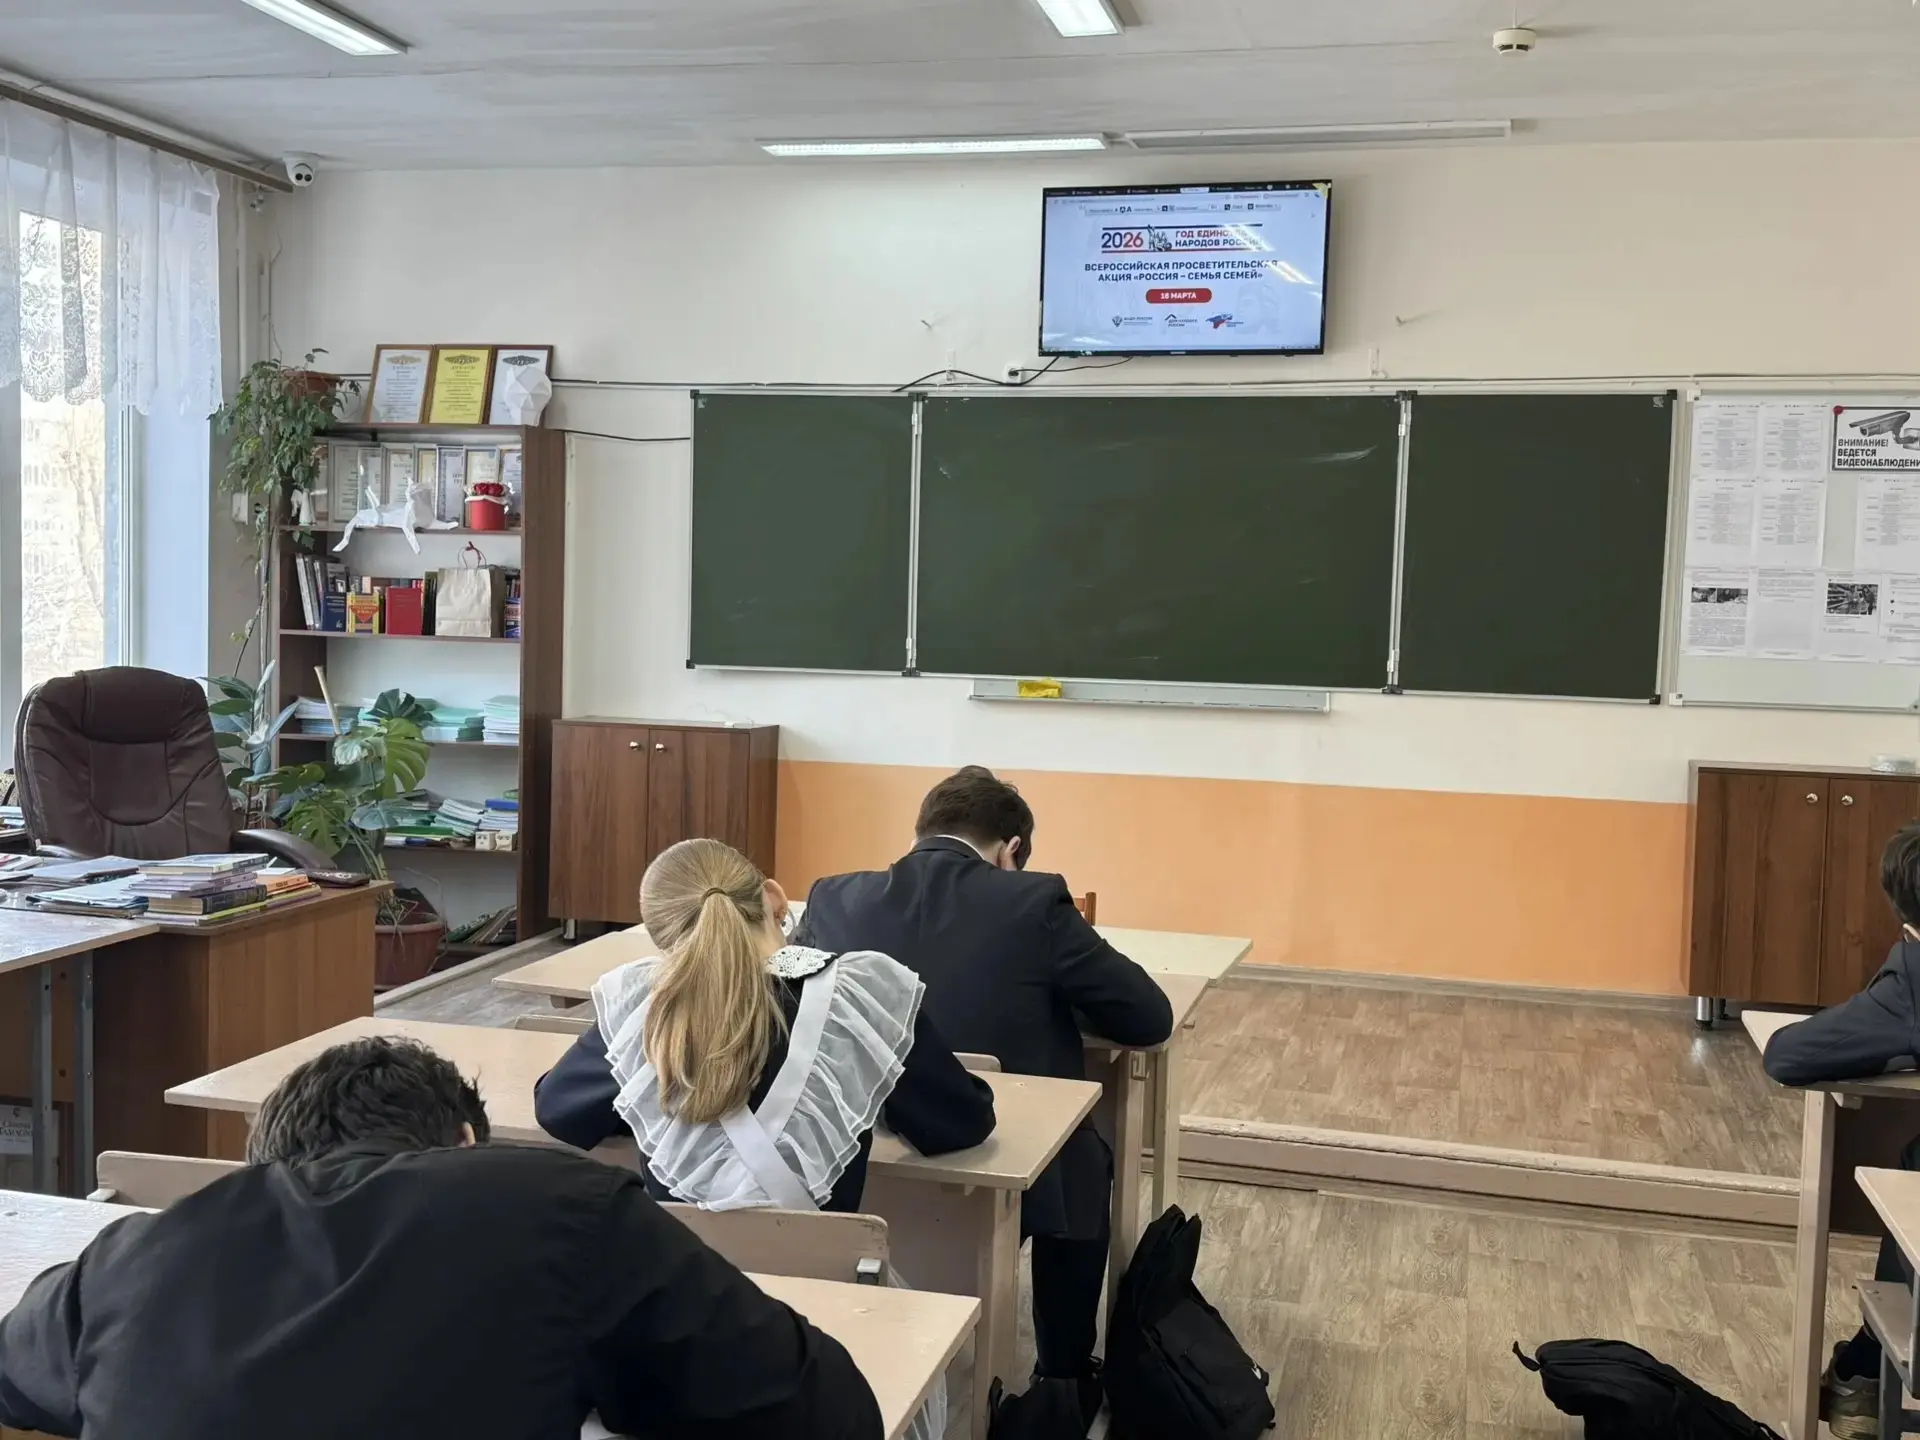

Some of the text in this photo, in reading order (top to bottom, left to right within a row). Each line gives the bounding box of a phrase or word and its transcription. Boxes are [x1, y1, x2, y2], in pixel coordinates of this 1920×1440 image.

[1175, 230, 1195, 240] ГОД
[1101, 232, 1144, 249] 2026
[1175, 238, 1220, 249] НАРОДОВ
[1084, 259, 1279, 272] ВСЕРОССИЙСКАЯ ПРОСВЕТИТЕЛЬСКАЯ
[1098, 272, 1132, 283] АКЦИЯ
[1133, 271, 1179, 282] «РОССИЯ
[1187, 271, 1221, 281] СЕМЬЯ
[1223, 269, 1263, 280] СЕМЕЙ»
[1160, 291, 1197, 300] 18 МАРТА
[1838, 438, 1889, 447] ВНИМАНИЕ!
[1837, 448, 1877, 458] ВЕДЕТСЯ
